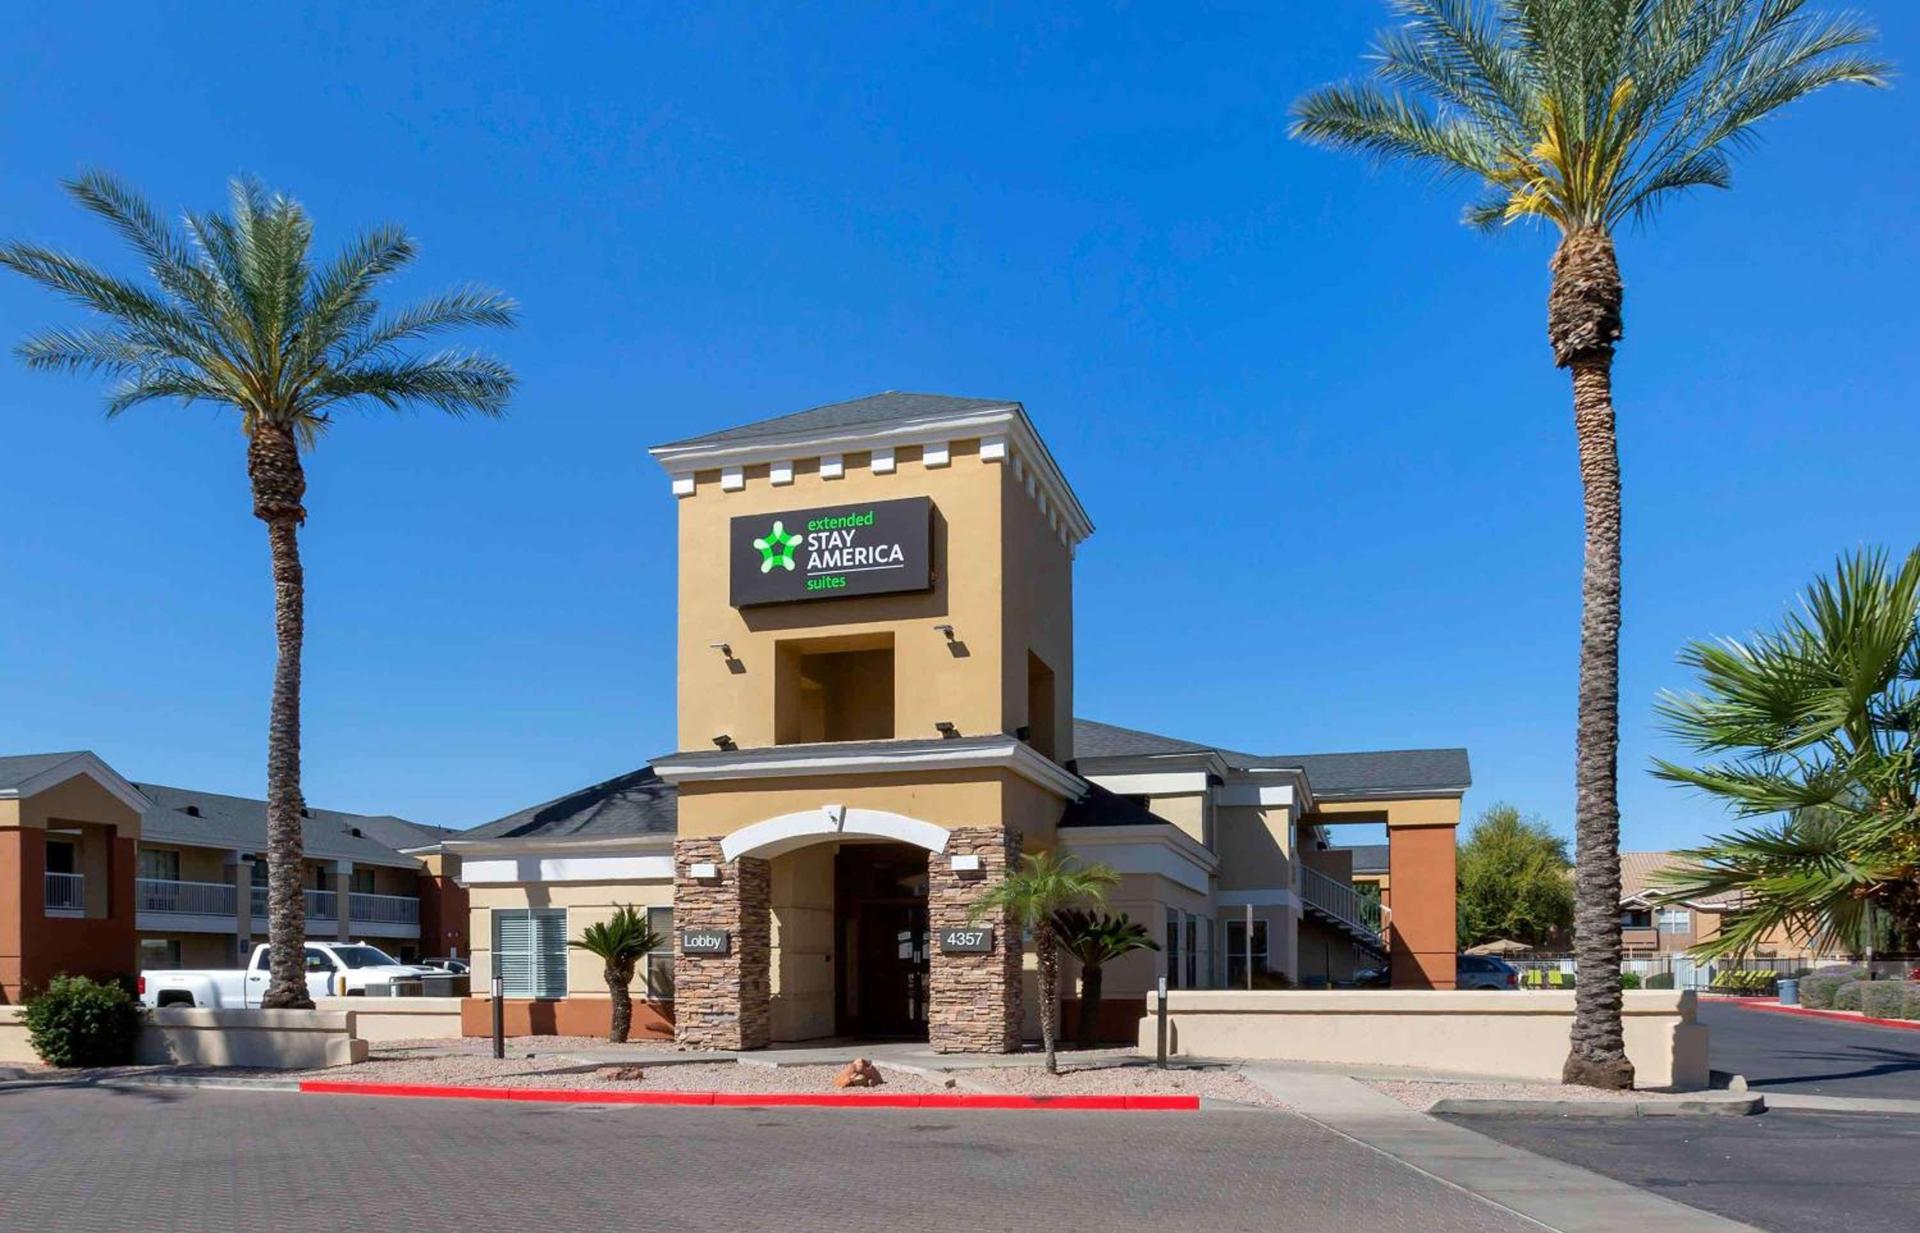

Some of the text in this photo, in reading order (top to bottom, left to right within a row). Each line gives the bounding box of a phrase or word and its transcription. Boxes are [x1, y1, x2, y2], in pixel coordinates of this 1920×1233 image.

[808, 511, 873, 531] extended
[807, 529, 856, 551] STAY
[807, 544, 904, 570] AMERICA
[807, 575, 846, 590] suites
[684, 934, 721, 950] Lobby
[946, 932, 984, 946] 4357
